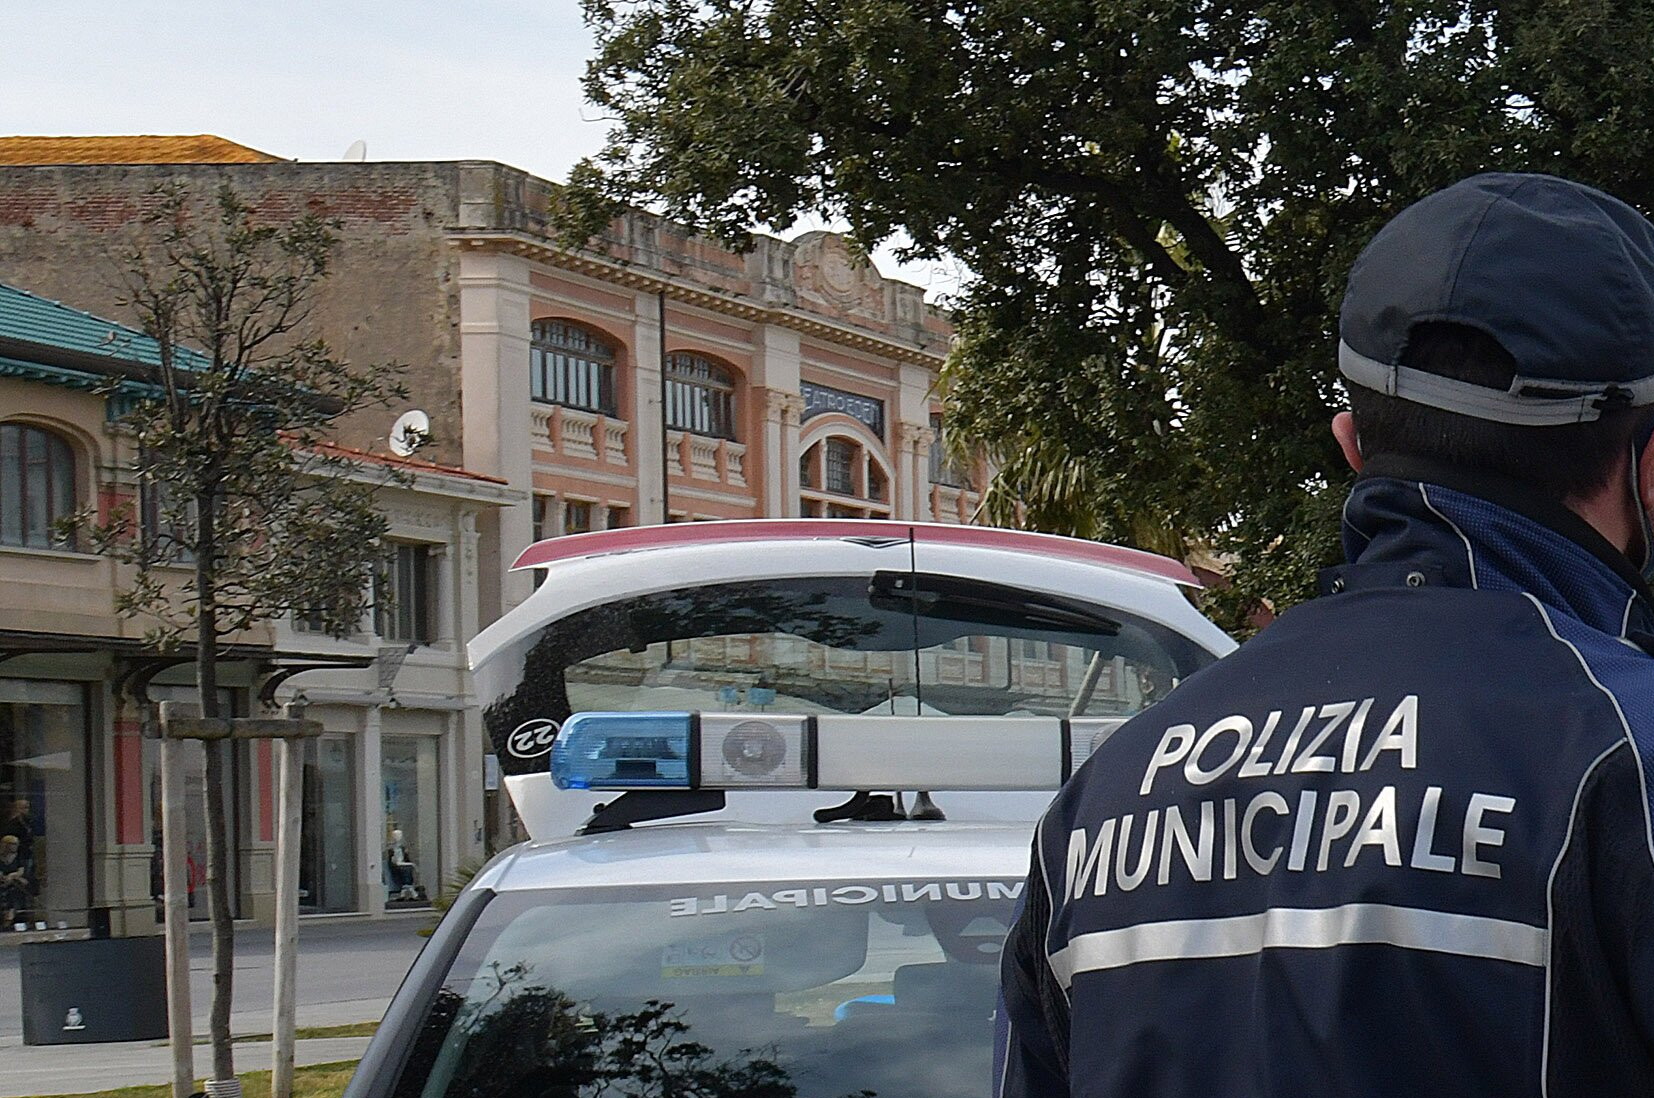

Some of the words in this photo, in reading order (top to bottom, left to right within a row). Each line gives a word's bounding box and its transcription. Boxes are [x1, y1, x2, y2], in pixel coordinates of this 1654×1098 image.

[513, 724, 555, 751] 22
[1138, 694, 1419, 797] POLIZIA
[1064, 785, 1517, 906] MUNICIPALE
